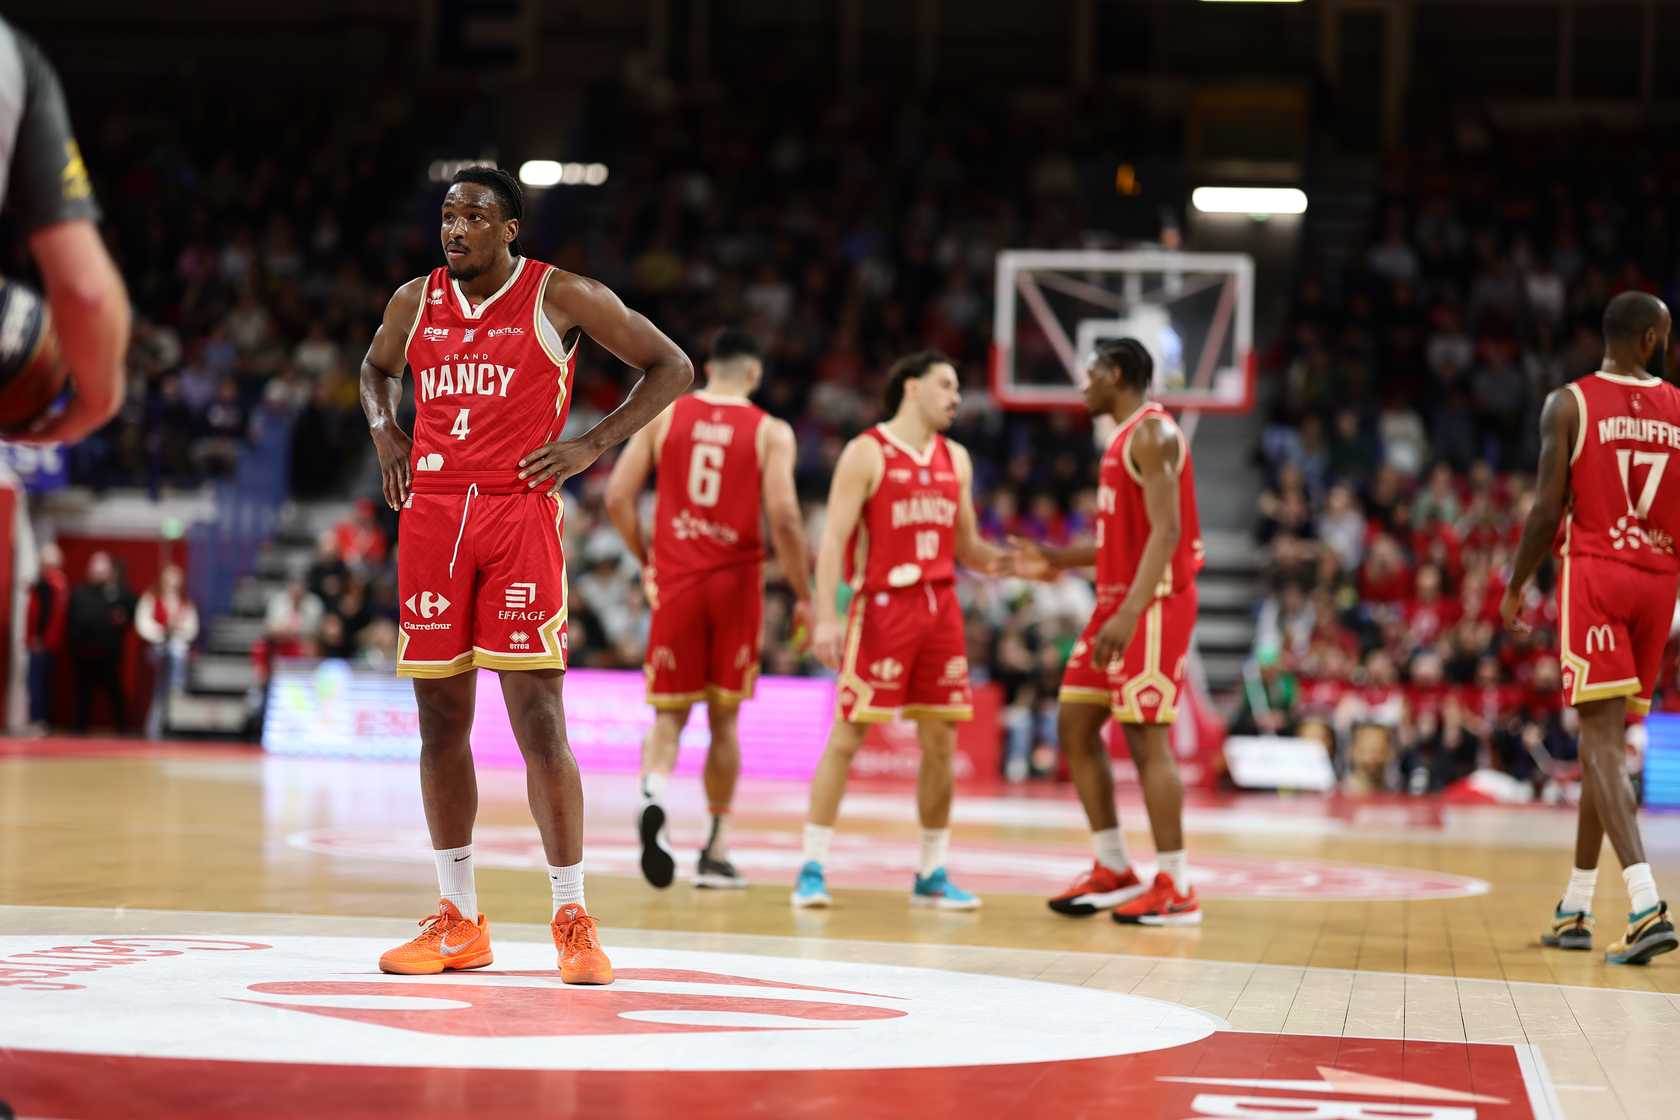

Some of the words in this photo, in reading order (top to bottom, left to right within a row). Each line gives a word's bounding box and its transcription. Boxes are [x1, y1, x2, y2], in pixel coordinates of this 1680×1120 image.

[444, 353, 489, 361] GRAND
[420, 363, 516, 403] NANCY
[450, 408, 471, 440] 4
[687, 443, 725, 508] 6
[1616, 449, 1669, 521] 17
[404, 622, 451, 630] Carrefour
